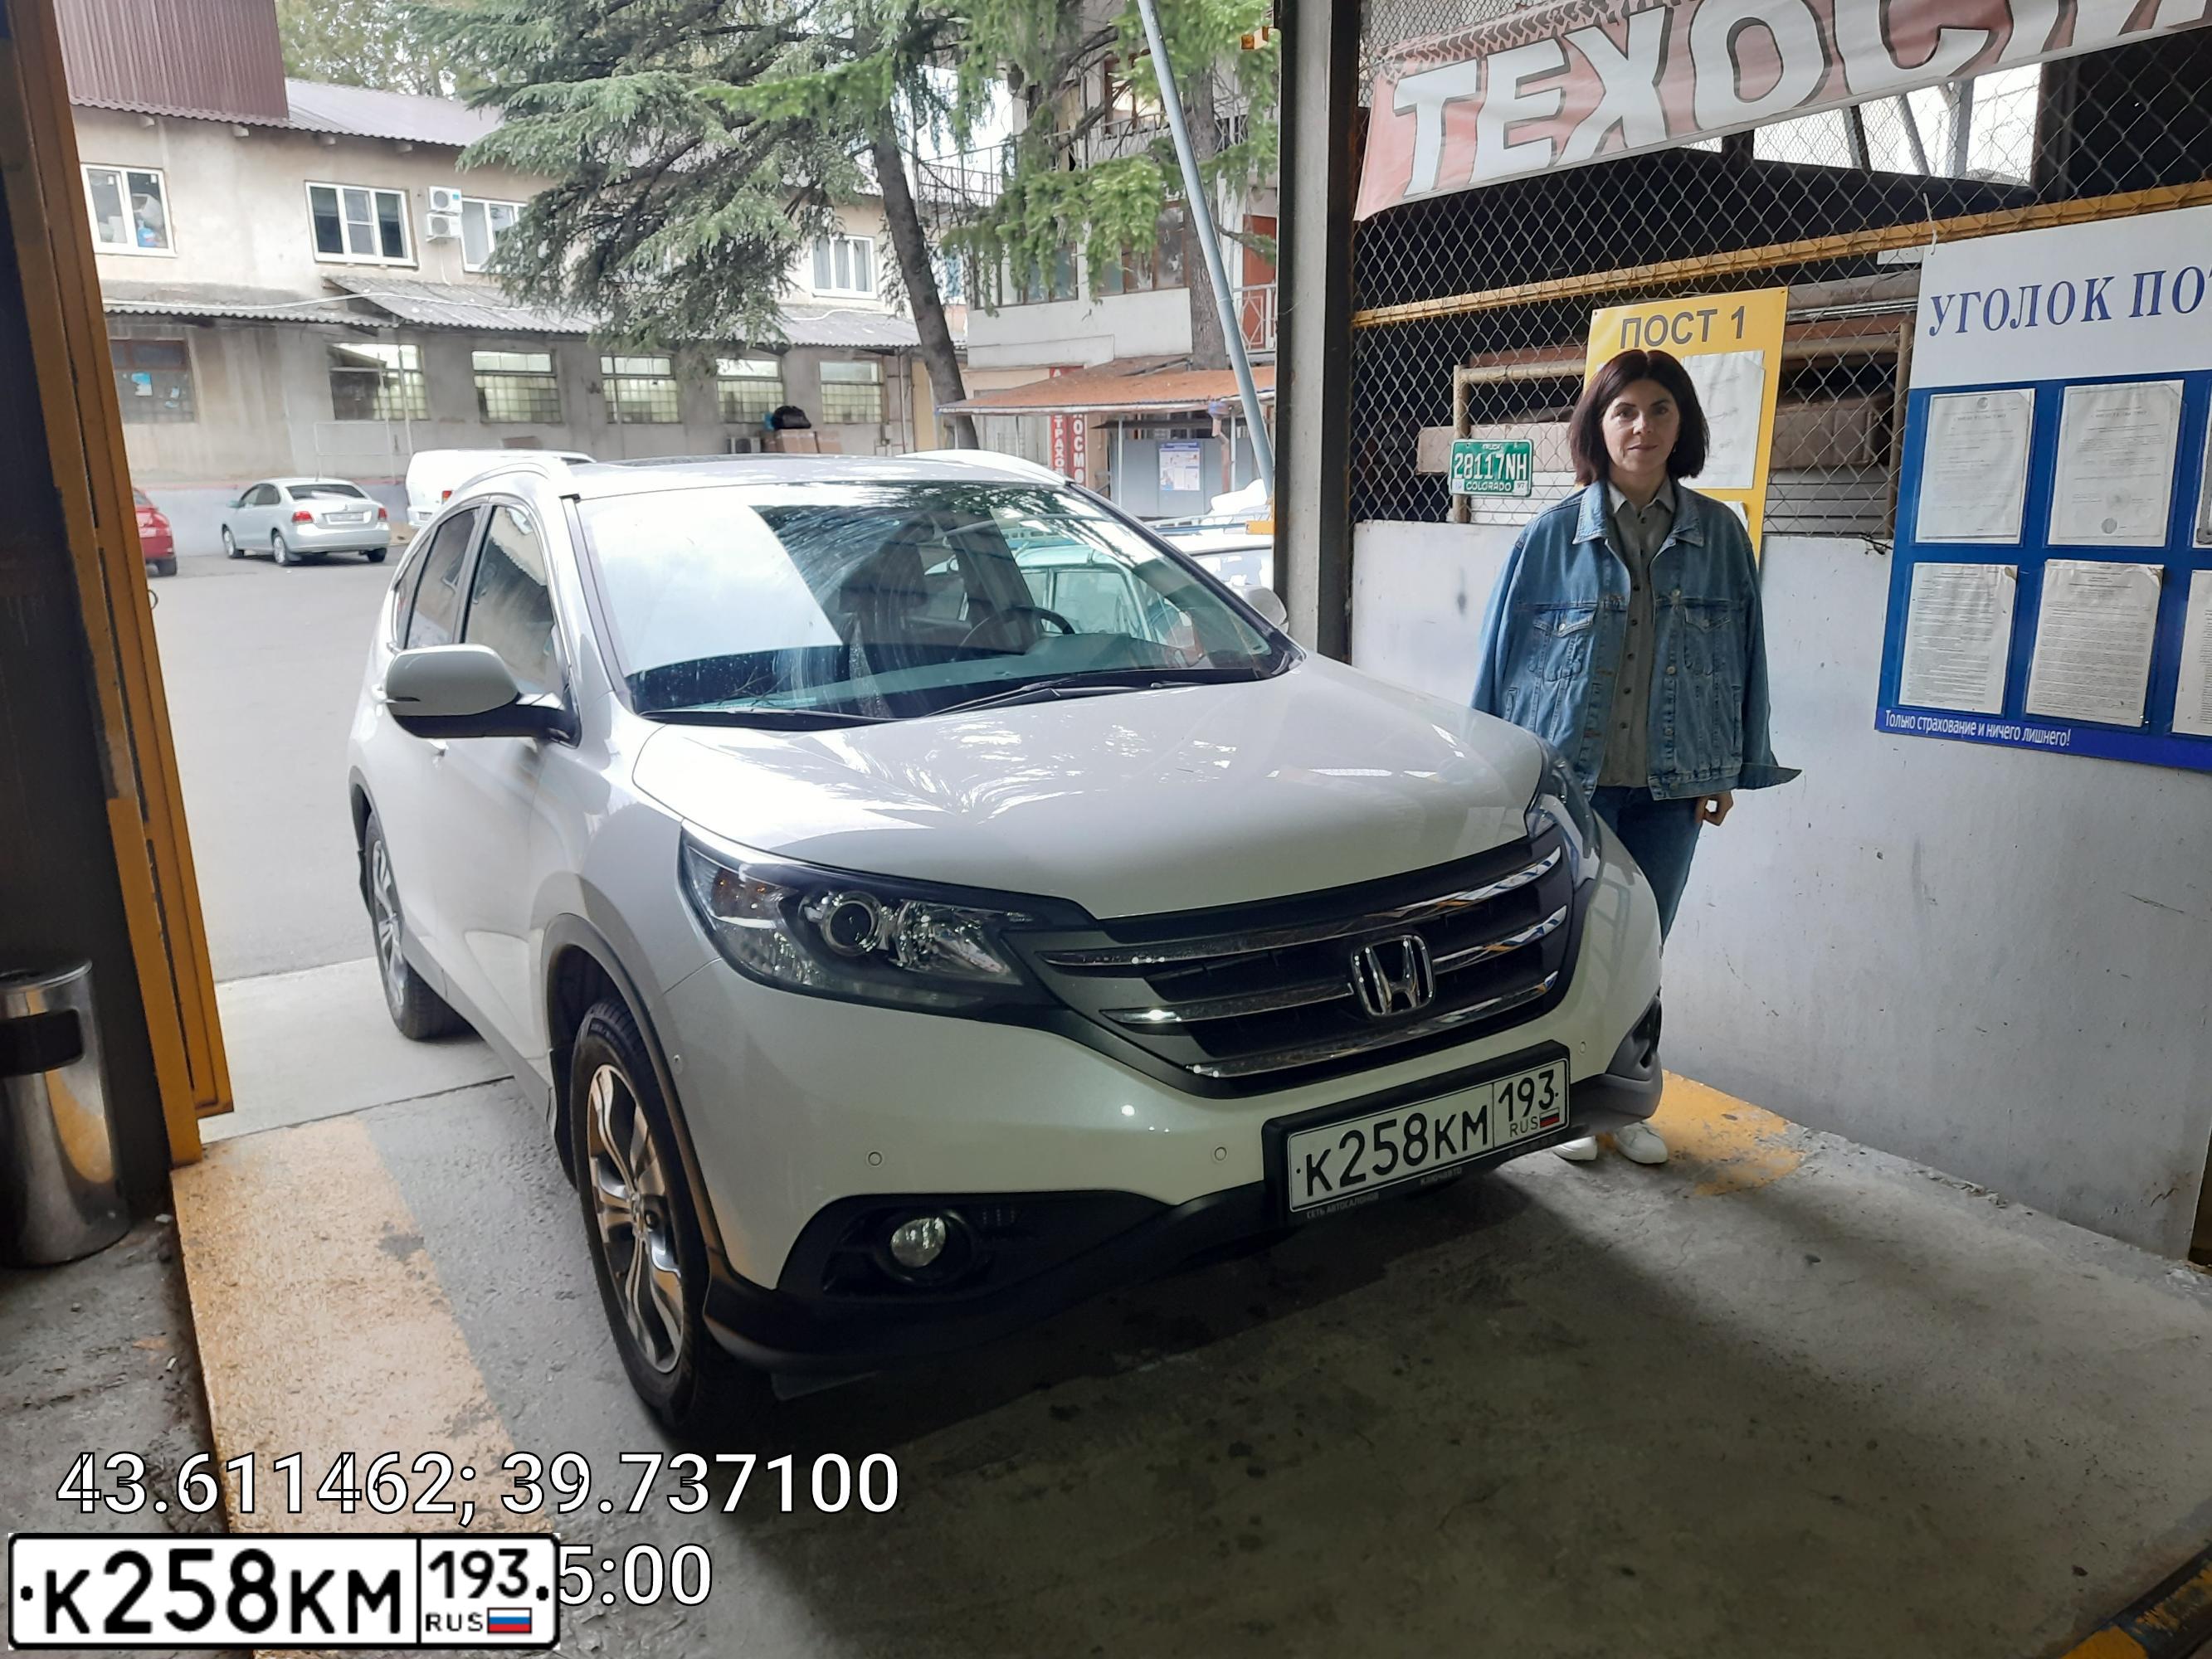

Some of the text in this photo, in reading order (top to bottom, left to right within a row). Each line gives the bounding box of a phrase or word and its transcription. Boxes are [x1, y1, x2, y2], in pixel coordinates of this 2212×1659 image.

[1394, 0, 2210, 197] ТЕХОС
[1928, 265, 2212, 337] УГОЛОК ПО
[1620, 305, 1745, 349] ПОСТ 1
[1454, 452, 1527, 480] 28117NH
[1465, 481, 1512, 492] COLORADO
[1884, 710, 2072, 747] Только страхование и ничего лишнего!
[1305, 1069, 1555, 1197] К258КМ 193
[1509, 1117, 1538, 1137] RUS
